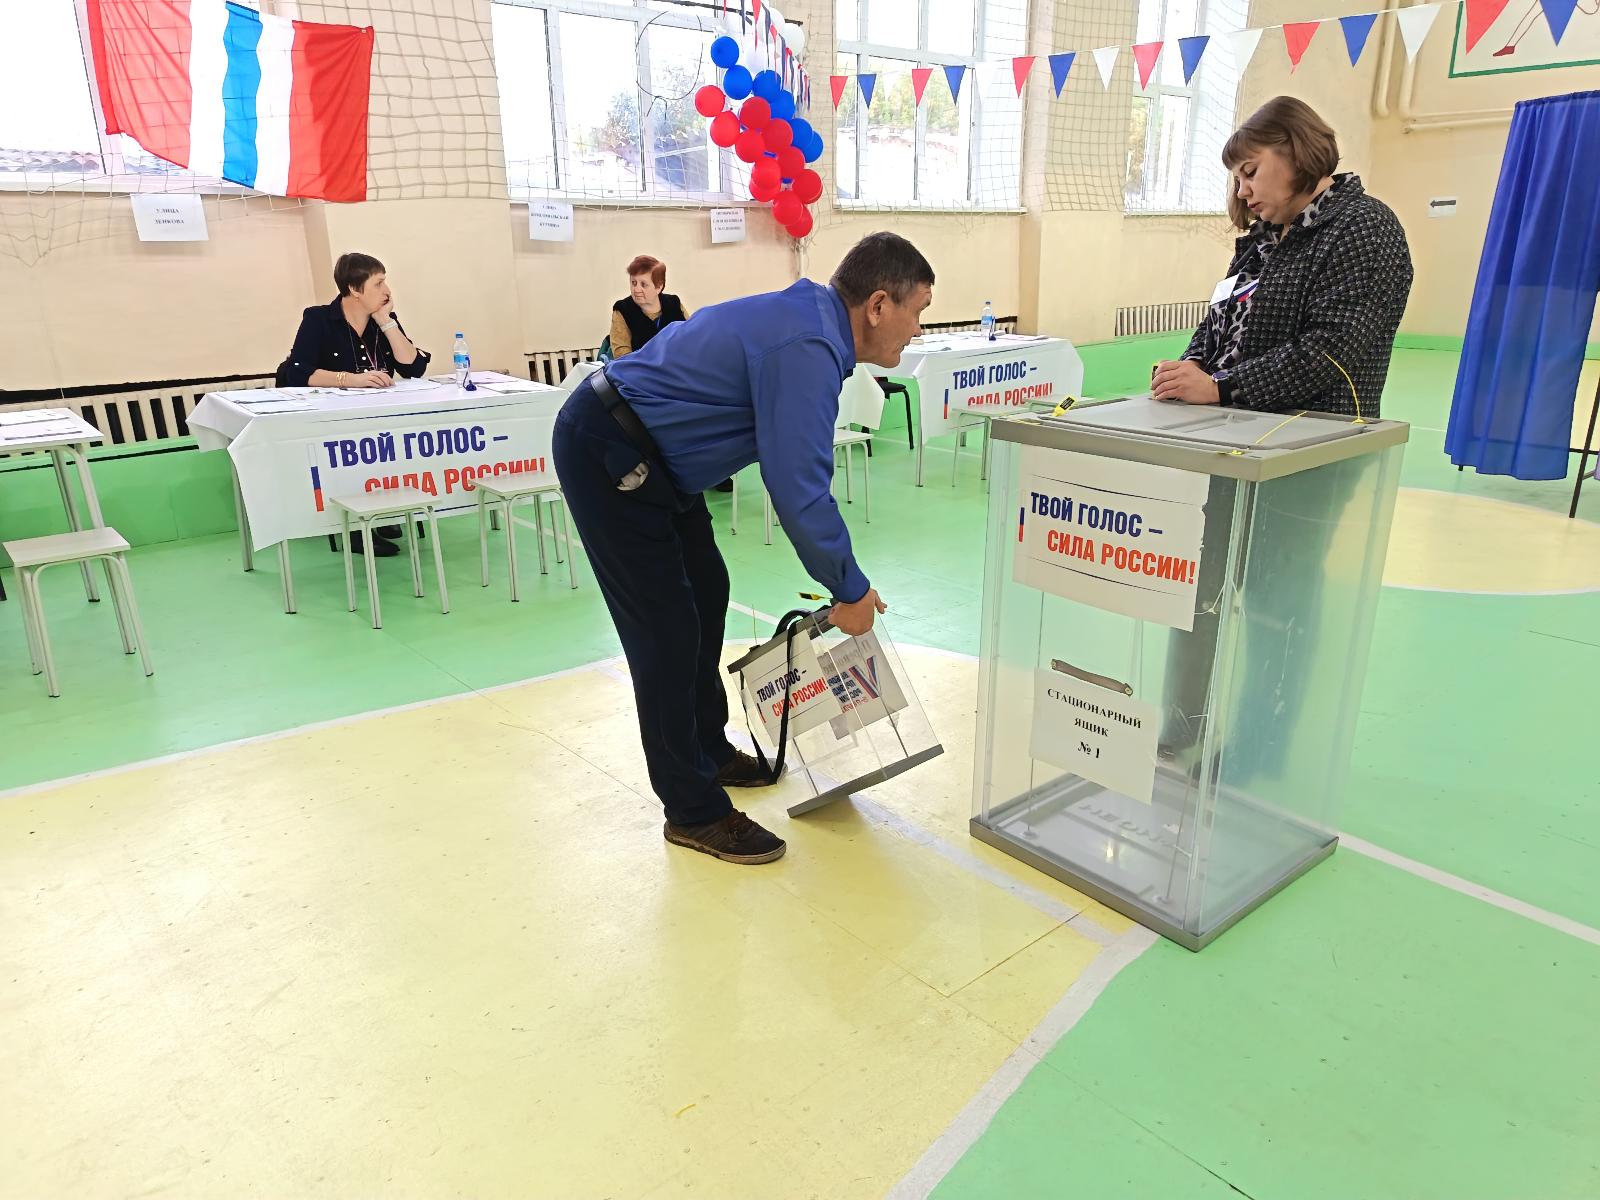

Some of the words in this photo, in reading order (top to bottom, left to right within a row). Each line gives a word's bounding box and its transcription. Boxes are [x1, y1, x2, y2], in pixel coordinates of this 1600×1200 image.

[952, 365, 985, 390] ТВОЙ
[988, 360, 1027, 384] ГОЛОС
[323, 432, 396, 468] ТВОЙ
[403, 425, 486, 460] ГОЛОС
[1030, 491, 1074, 523] ТВОЙ
[1077, 502, 1143, 538] ГОЛОС
[1047, 529, 1096, 563] СИЛА
[1100, 542, 1197, 584] РОССИИ!
[756, 681, 777, 703] ТВОЙ
[791, 677, 829, 706] РОССИИ!
[1047, 688, 1142, 729] СТАЦИОНАРНЫЙ
[1074, 717, 1109, 737] ЯЩИК
[1077, 741, 1092, 755] №
[1095, 748, 1101, 759] 1
